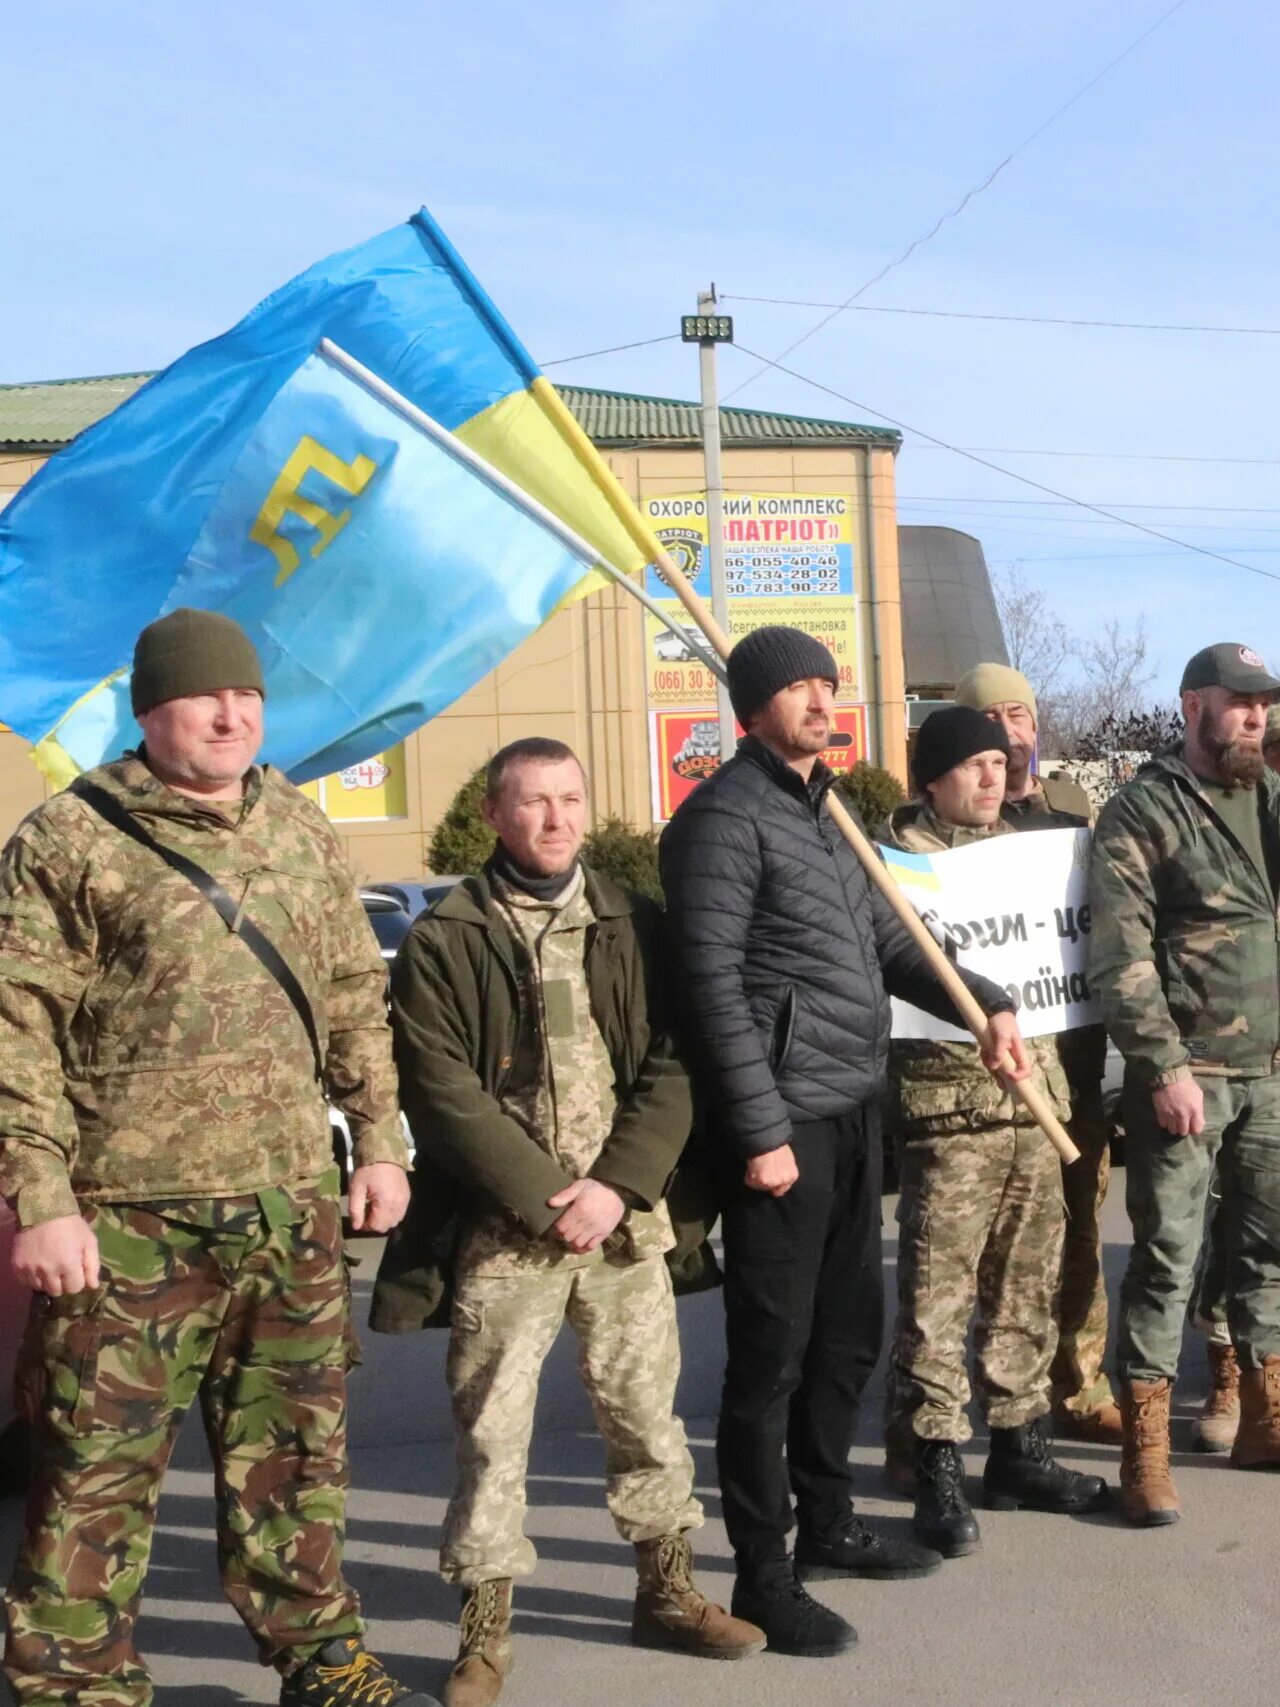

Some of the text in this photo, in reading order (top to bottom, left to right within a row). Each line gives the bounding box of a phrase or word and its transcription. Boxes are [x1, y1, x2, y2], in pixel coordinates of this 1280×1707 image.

[650, 496, 846, 517] ОХОРОИЙ КОМПЛЕКС
[746, 545, 780, 554] БЕЗПЕКА
[805, 544, 835, 553] РОБОТА
[725, 556, 837, 568] 66-055-40-46
[726, 569, 838, 581] 97-534-28-02
[726, 582, 839, 594] 50-783-90-22
[655, 671, 684, 690] (066)
[689, 671, 703, 689] 30
[359, 766, 374, 785] 4
[1054, 904, 1092, 945] це
[1005, 965, 1092, 1012] аїна
